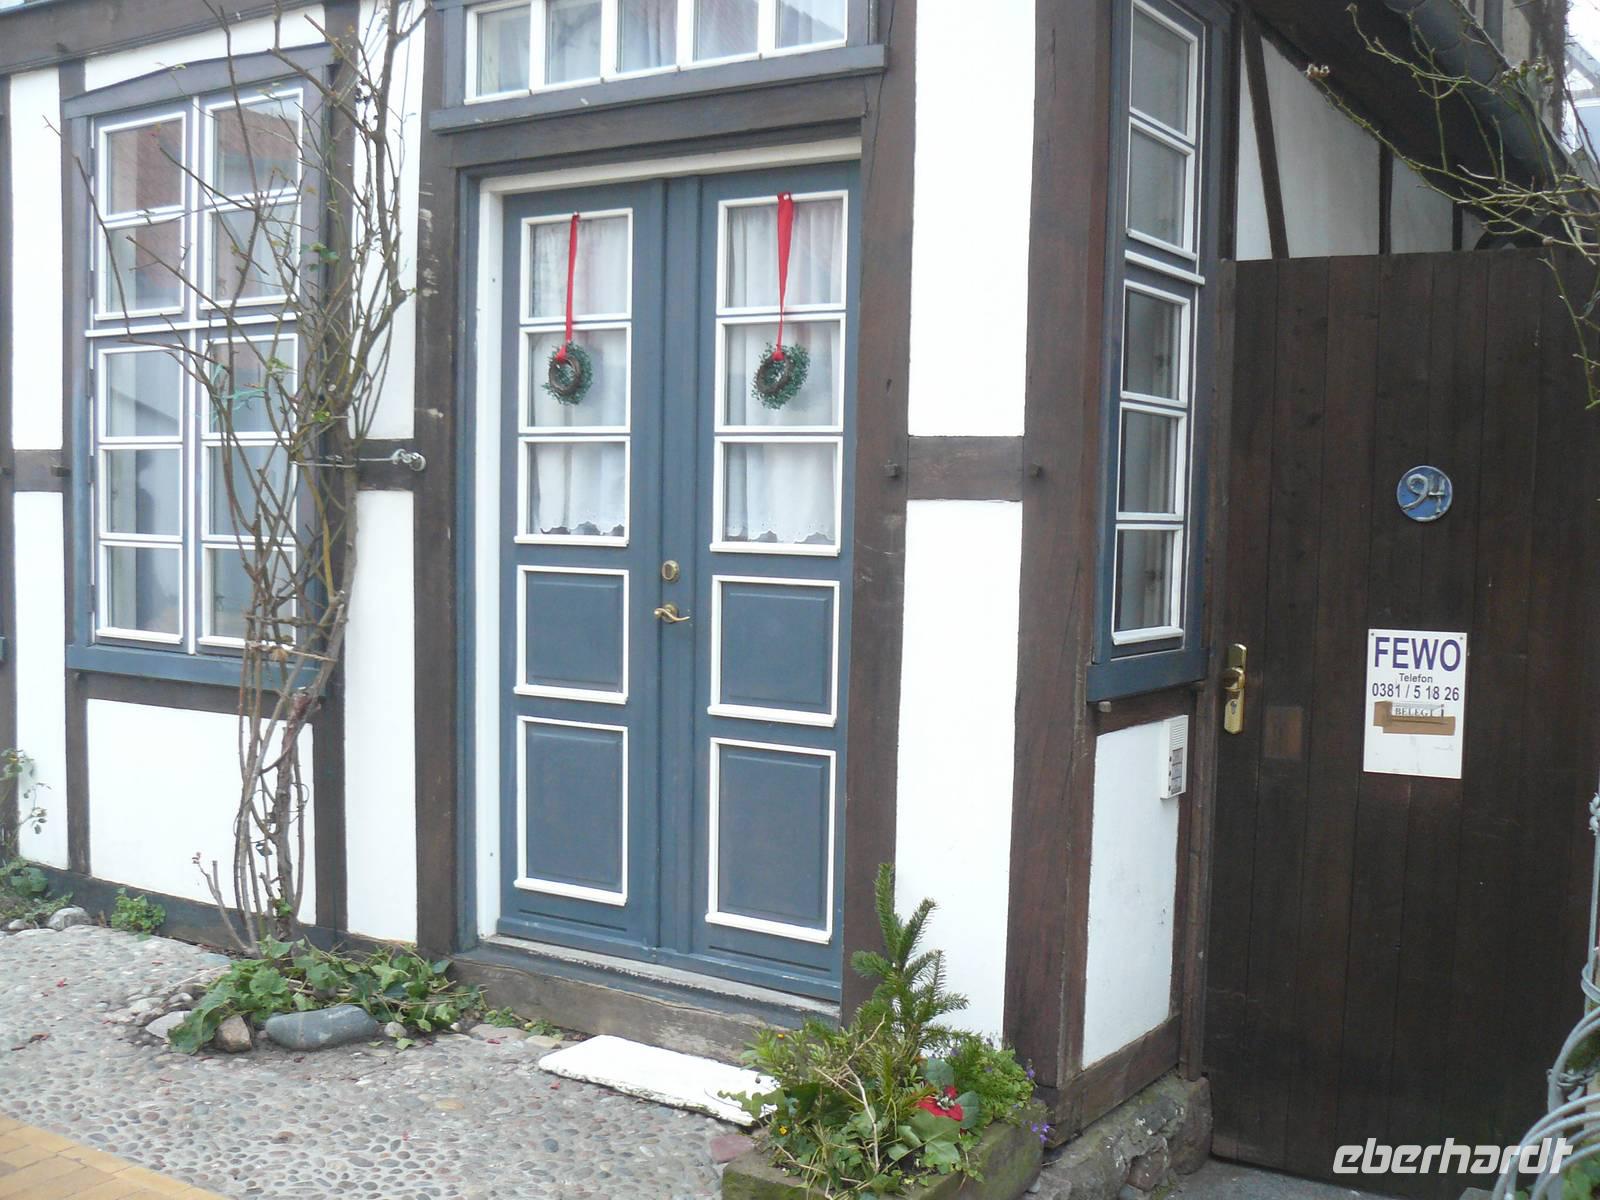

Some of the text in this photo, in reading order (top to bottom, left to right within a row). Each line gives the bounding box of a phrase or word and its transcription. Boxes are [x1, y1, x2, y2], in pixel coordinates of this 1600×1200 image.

[1401, 474, 1446, 513] 94
[1374, 636, 1461, 671] FEWO
[1399, 672, 1433, 683] Telefon
[1372, 682, 1401, 698] 0381
[1414, 685, 1421, 699] 5
[1426, 686, 1440, 700] 18
[1444, 687, 1460, 701] 26
